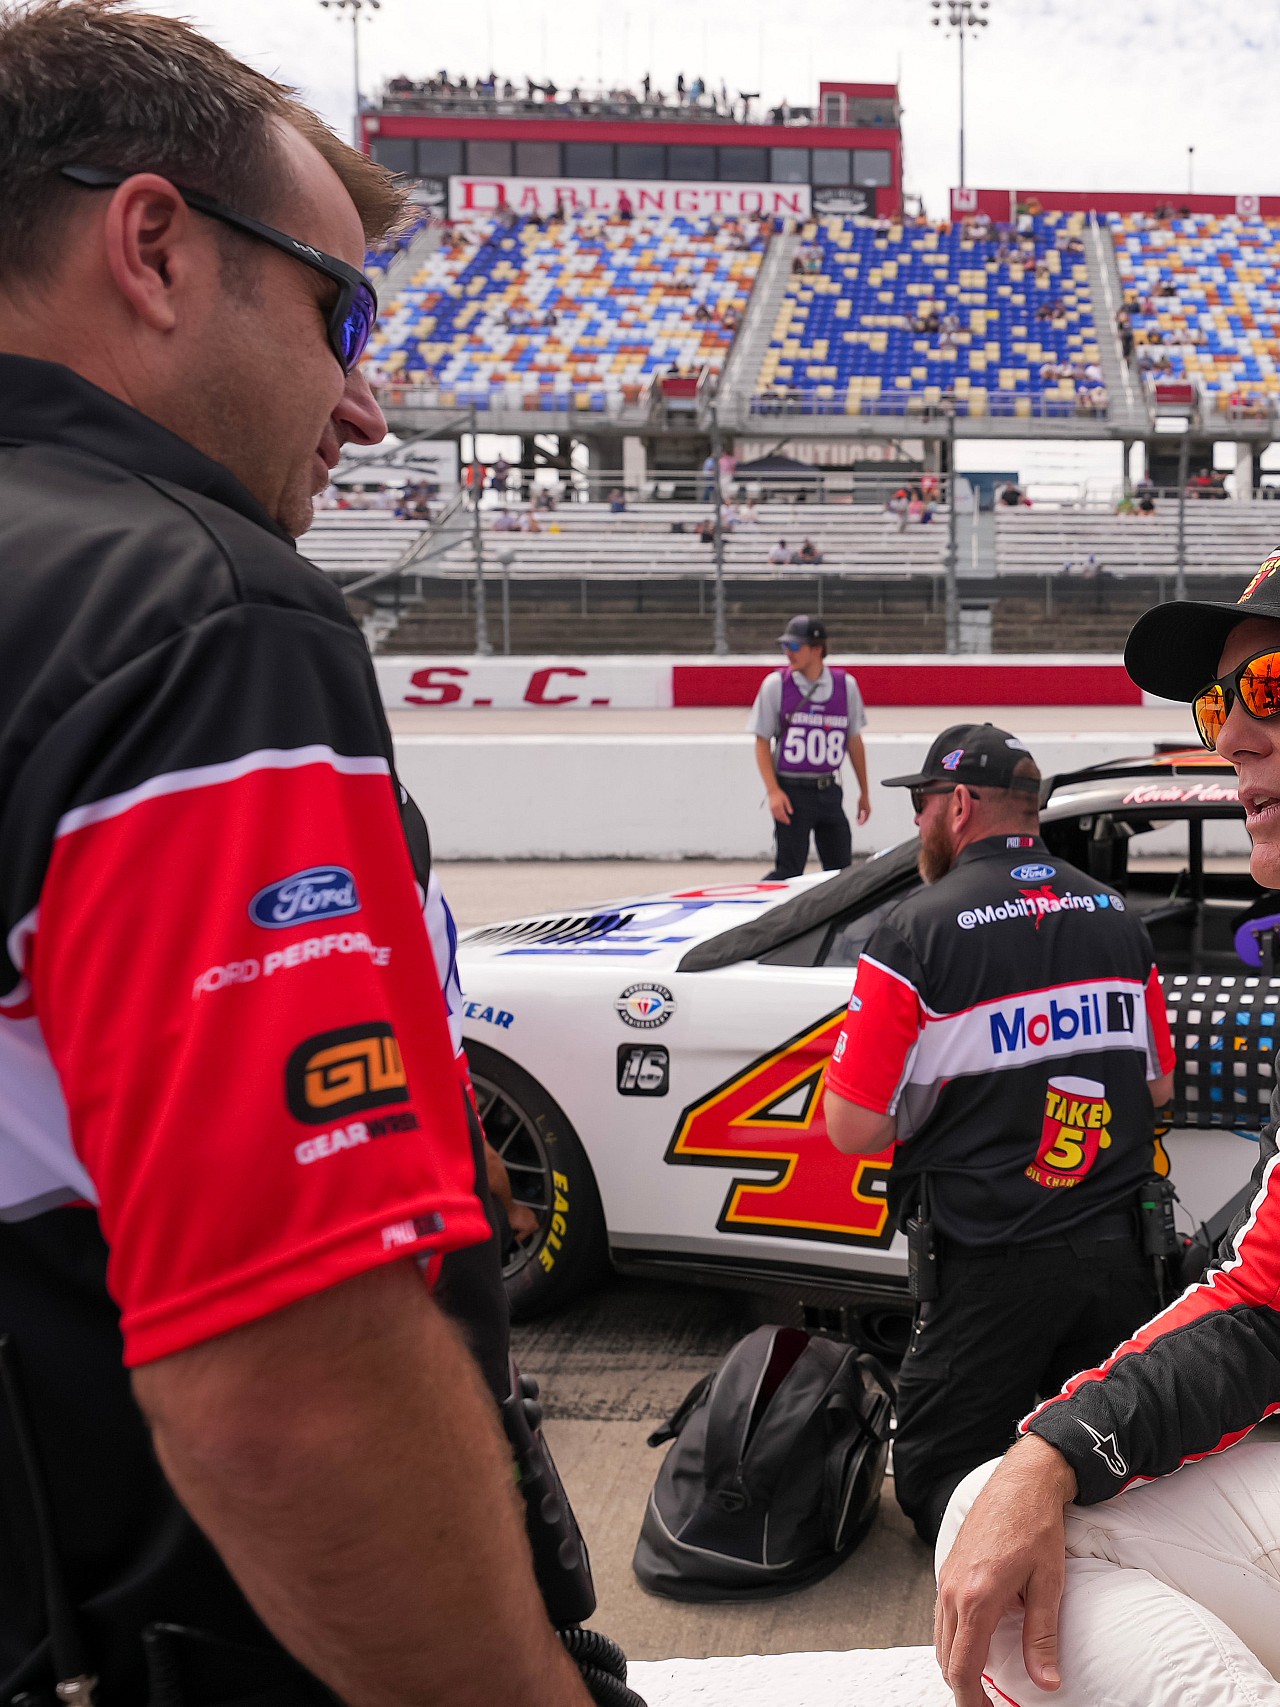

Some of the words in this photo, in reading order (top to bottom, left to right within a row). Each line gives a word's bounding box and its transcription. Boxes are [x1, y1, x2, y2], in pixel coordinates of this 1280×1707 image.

[460, 181, 802, 214] DARLINGTON
[404, 667, 494, 706] S.
[523, 667, 611, 706] C.
[783, 726, 845, 768] 508
[941, 749, 965, 771] 4
[272, 873, 357, 922] Ford
[957, 892, 1096, 930] @Mobil1Racing
[990, 993, 1102, 1054] Mobil
[664, 1001, 898, 1250] 4
[1046, 1091, 1103, 1129] TAKE
[1044, 1126, 1085, 1169] 5
[1026, 1167, 1041, 1182] OIL
[1045, 1175, 1081, 1188] CHAN
[539, 1169, 570, 1273] EAGLE
